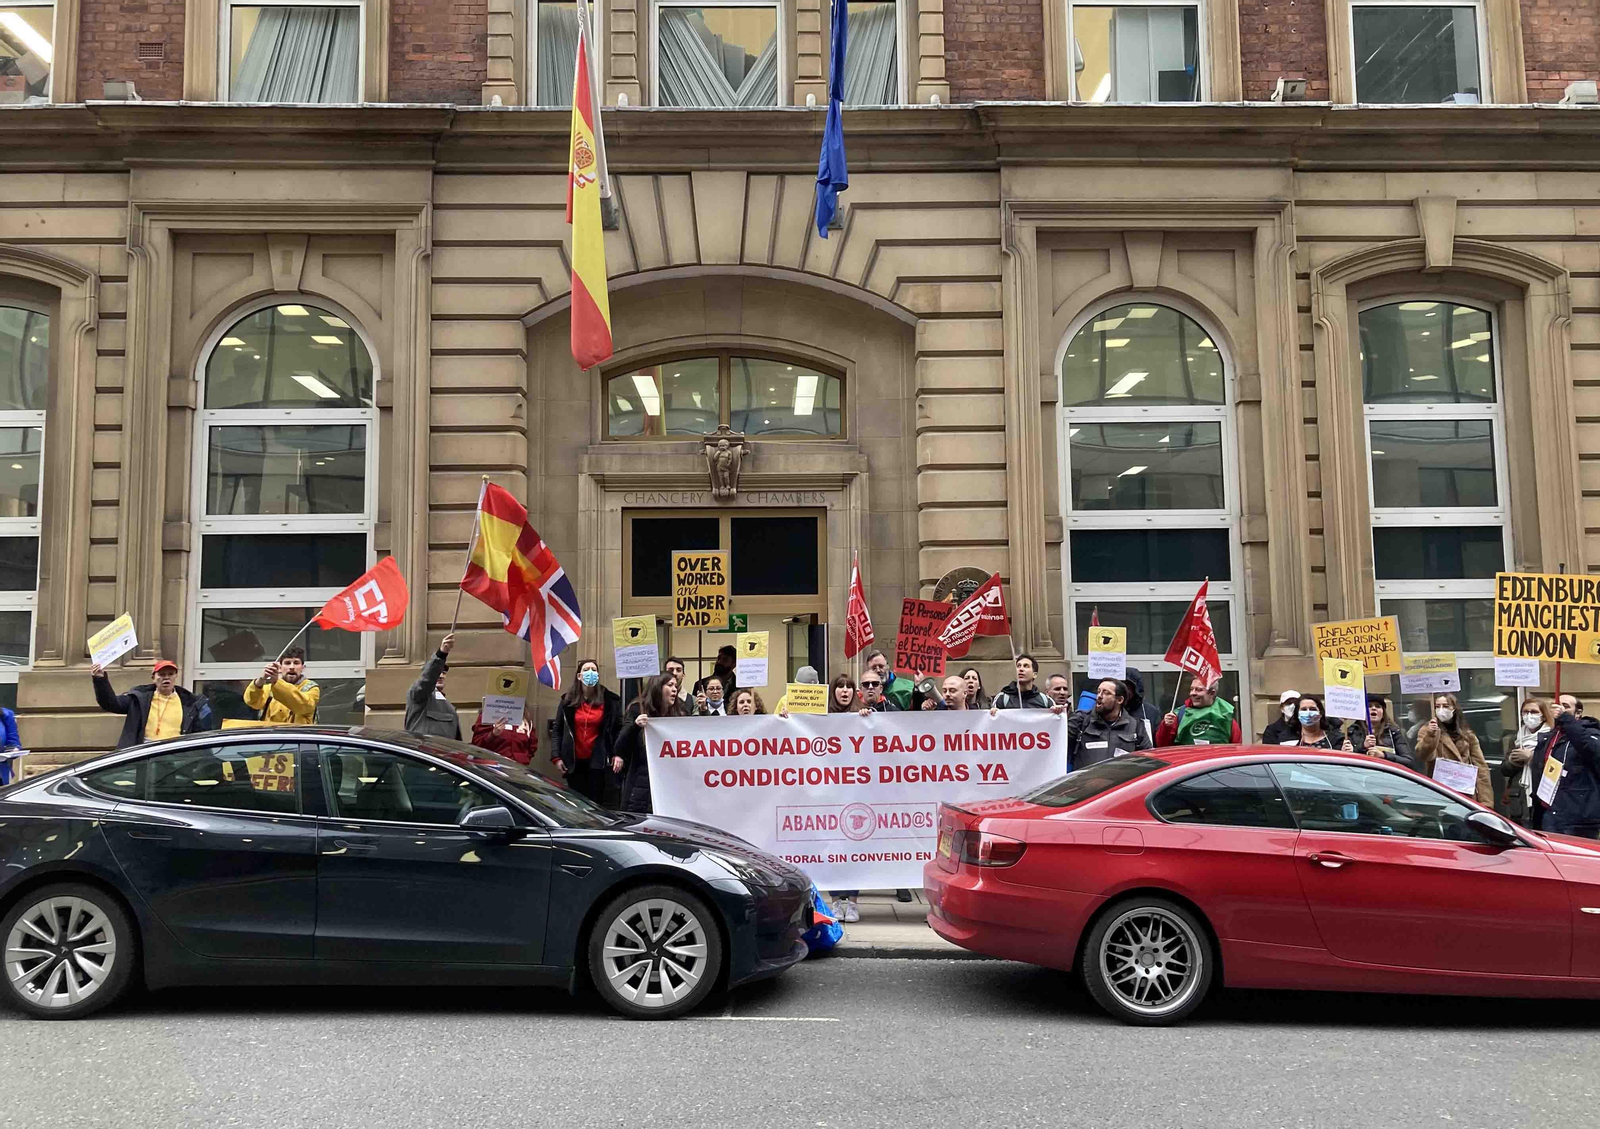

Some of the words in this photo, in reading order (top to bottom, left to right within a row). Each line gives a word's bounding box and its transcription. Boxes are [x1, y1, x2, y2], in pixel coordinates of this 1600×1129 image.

[623, 492, 704, 505] CHANCERY
[746, 491, 826, 504] CHAMBERS
[677, 556, 721, 572] OVER
[676, 572, 726, 586] WORKED
[677, 585, 699, 596] and
[676, 595, 725, 612] UNDER
[902, 601, 915, 616] El
[917, 603, 953, 620] Personal
[677, 611, 711, 626] PAID
[900, 617, 933, 637] Laboral
[1498, 602, 1600, 633] MANCHEST
[1316, 623, 1380, 639] INFLATION
[1319, 636, 1351, 648] KEEPS
[1353, 633, 1386, 645] RISING
[898, 637, 908, 651] el
[911, 637, 943, 656] Exterior
[1320, 647, 1348, 660] OUR
[1350, 641, 1396, 657] SALARIES
[1497, 629, 1577, 660] LONDON
[896, 652, 942, 673] EXISTE
[659, 736, 842, 758] ABANDONAD@S
[849, 735, 865, 754] Y
[873, 734, 936, 753] BAJO
[944, 729, 1051, 751] MÍNIMOS
[259, 754, 288, 774] IS
[704, 766, 871, 788] CONDICIONES
[879, 764, 970, 783] DIGNAS
[976, 763, 1009, 782] YA
[782, 814, 839, 832] ABAND
[877, 811, 933, 829] NAD@S
[828, 854, 847, 863] SIN
[851, 852, 912, 862] CONVENIO
[915, 851, 932, 861] EN
